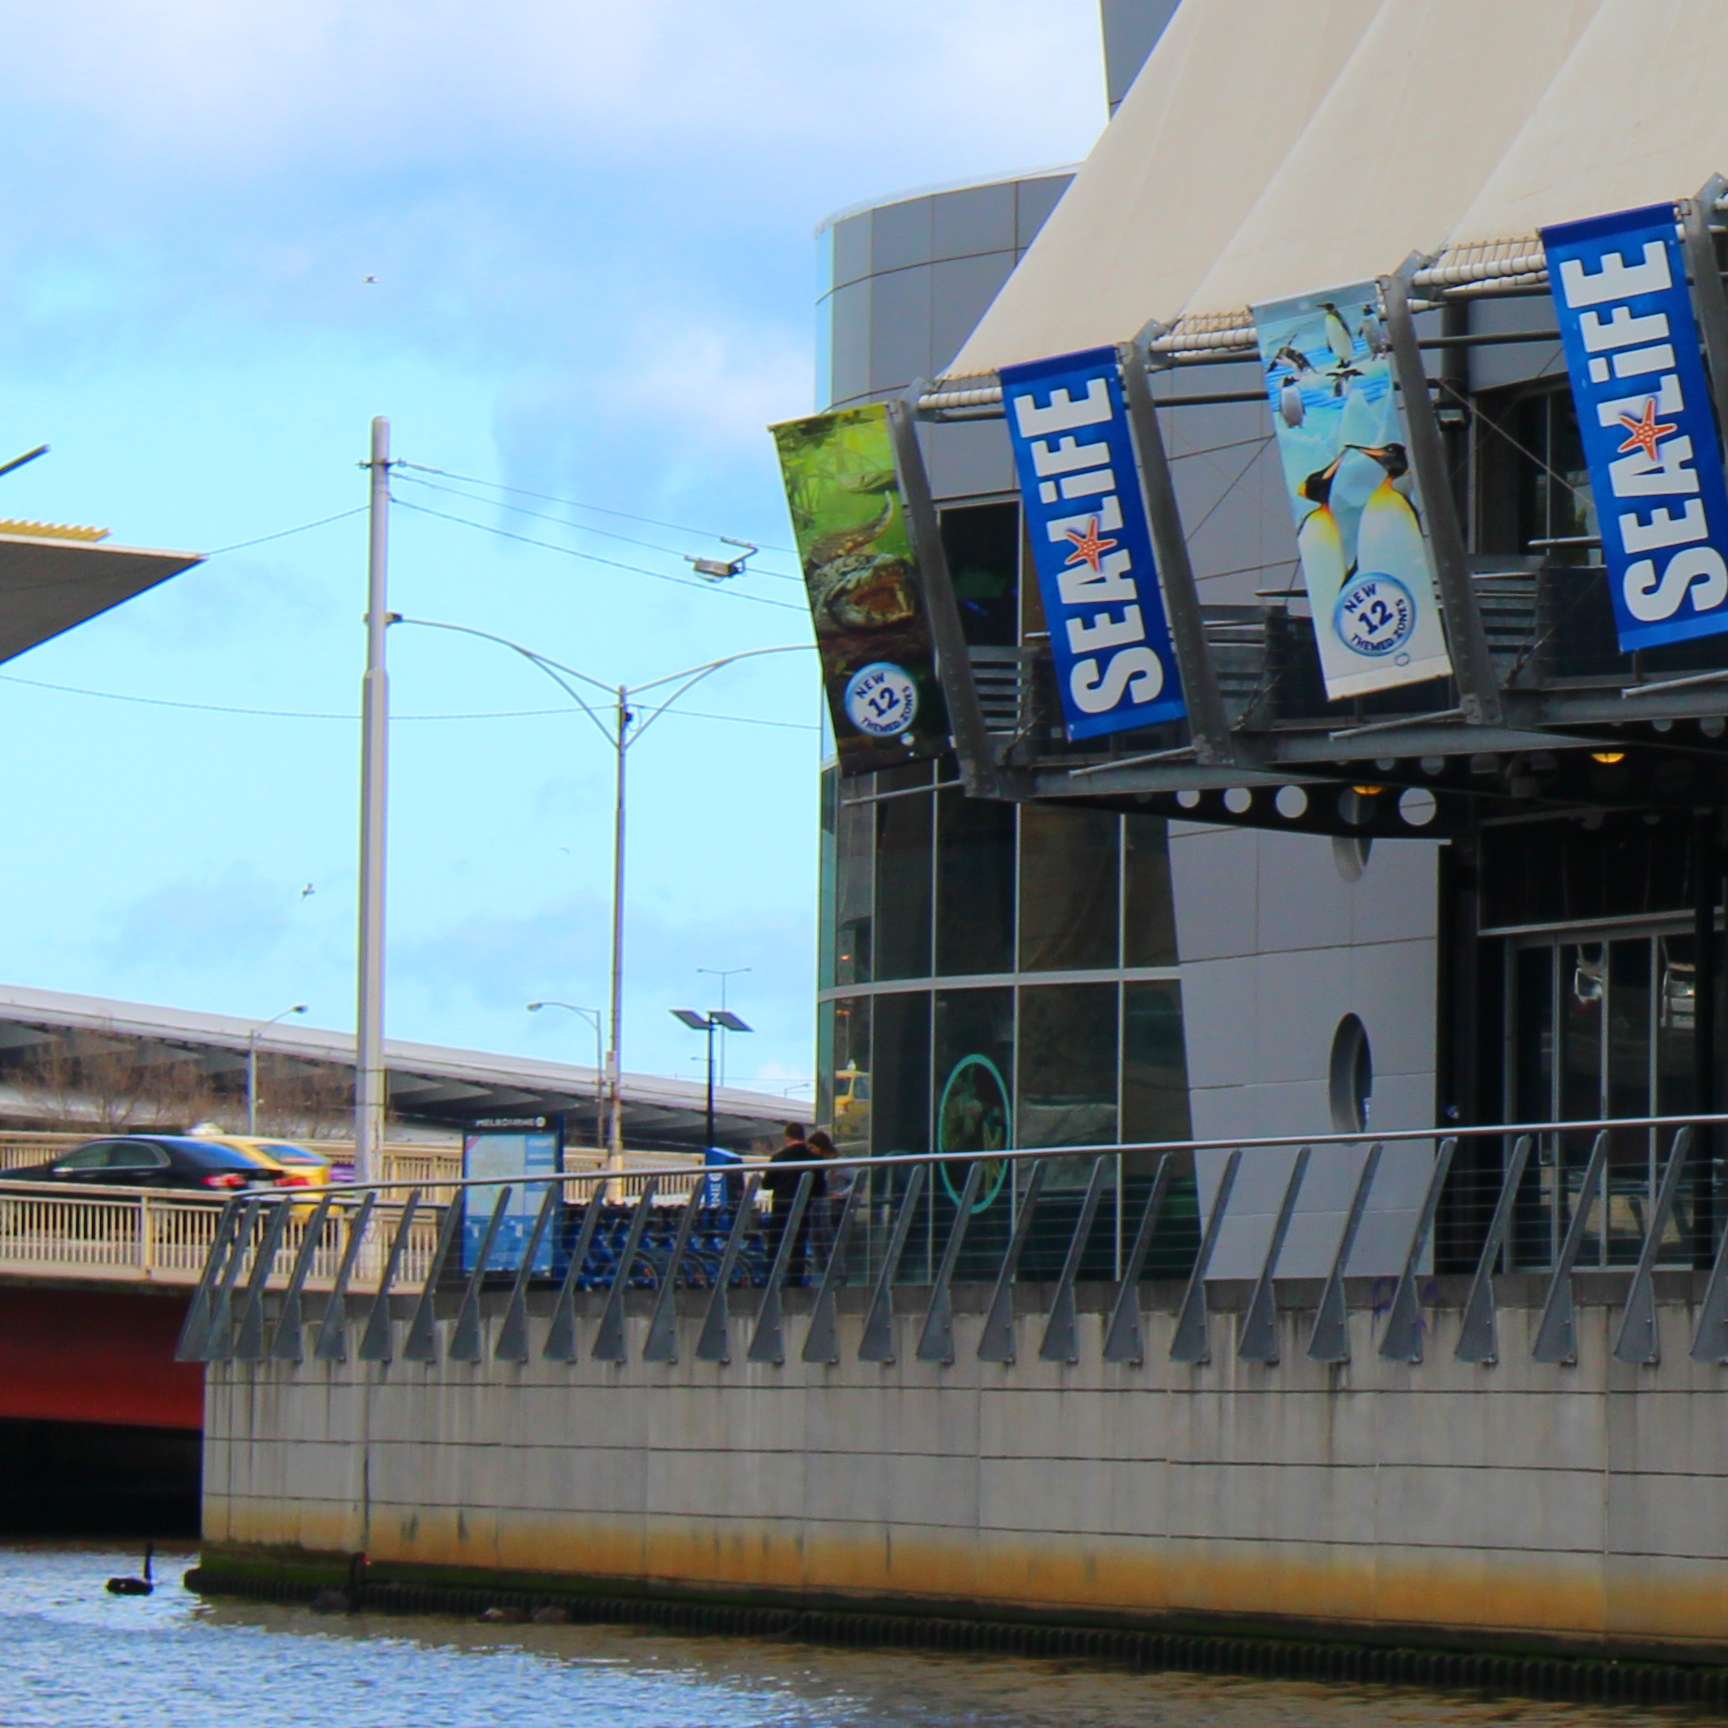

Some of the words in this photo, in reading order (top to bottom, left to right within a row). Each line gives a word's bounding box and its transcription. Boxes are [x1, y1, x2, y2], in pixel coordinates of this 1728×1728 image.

[1344, 583, 1376, 613] NEW
[1056, 549, 1165, 714] SEA
[1358, 599, 1394, 635] 12
[855, 672, 885, 699] NEW
[868, 687, 900, 718] 12
